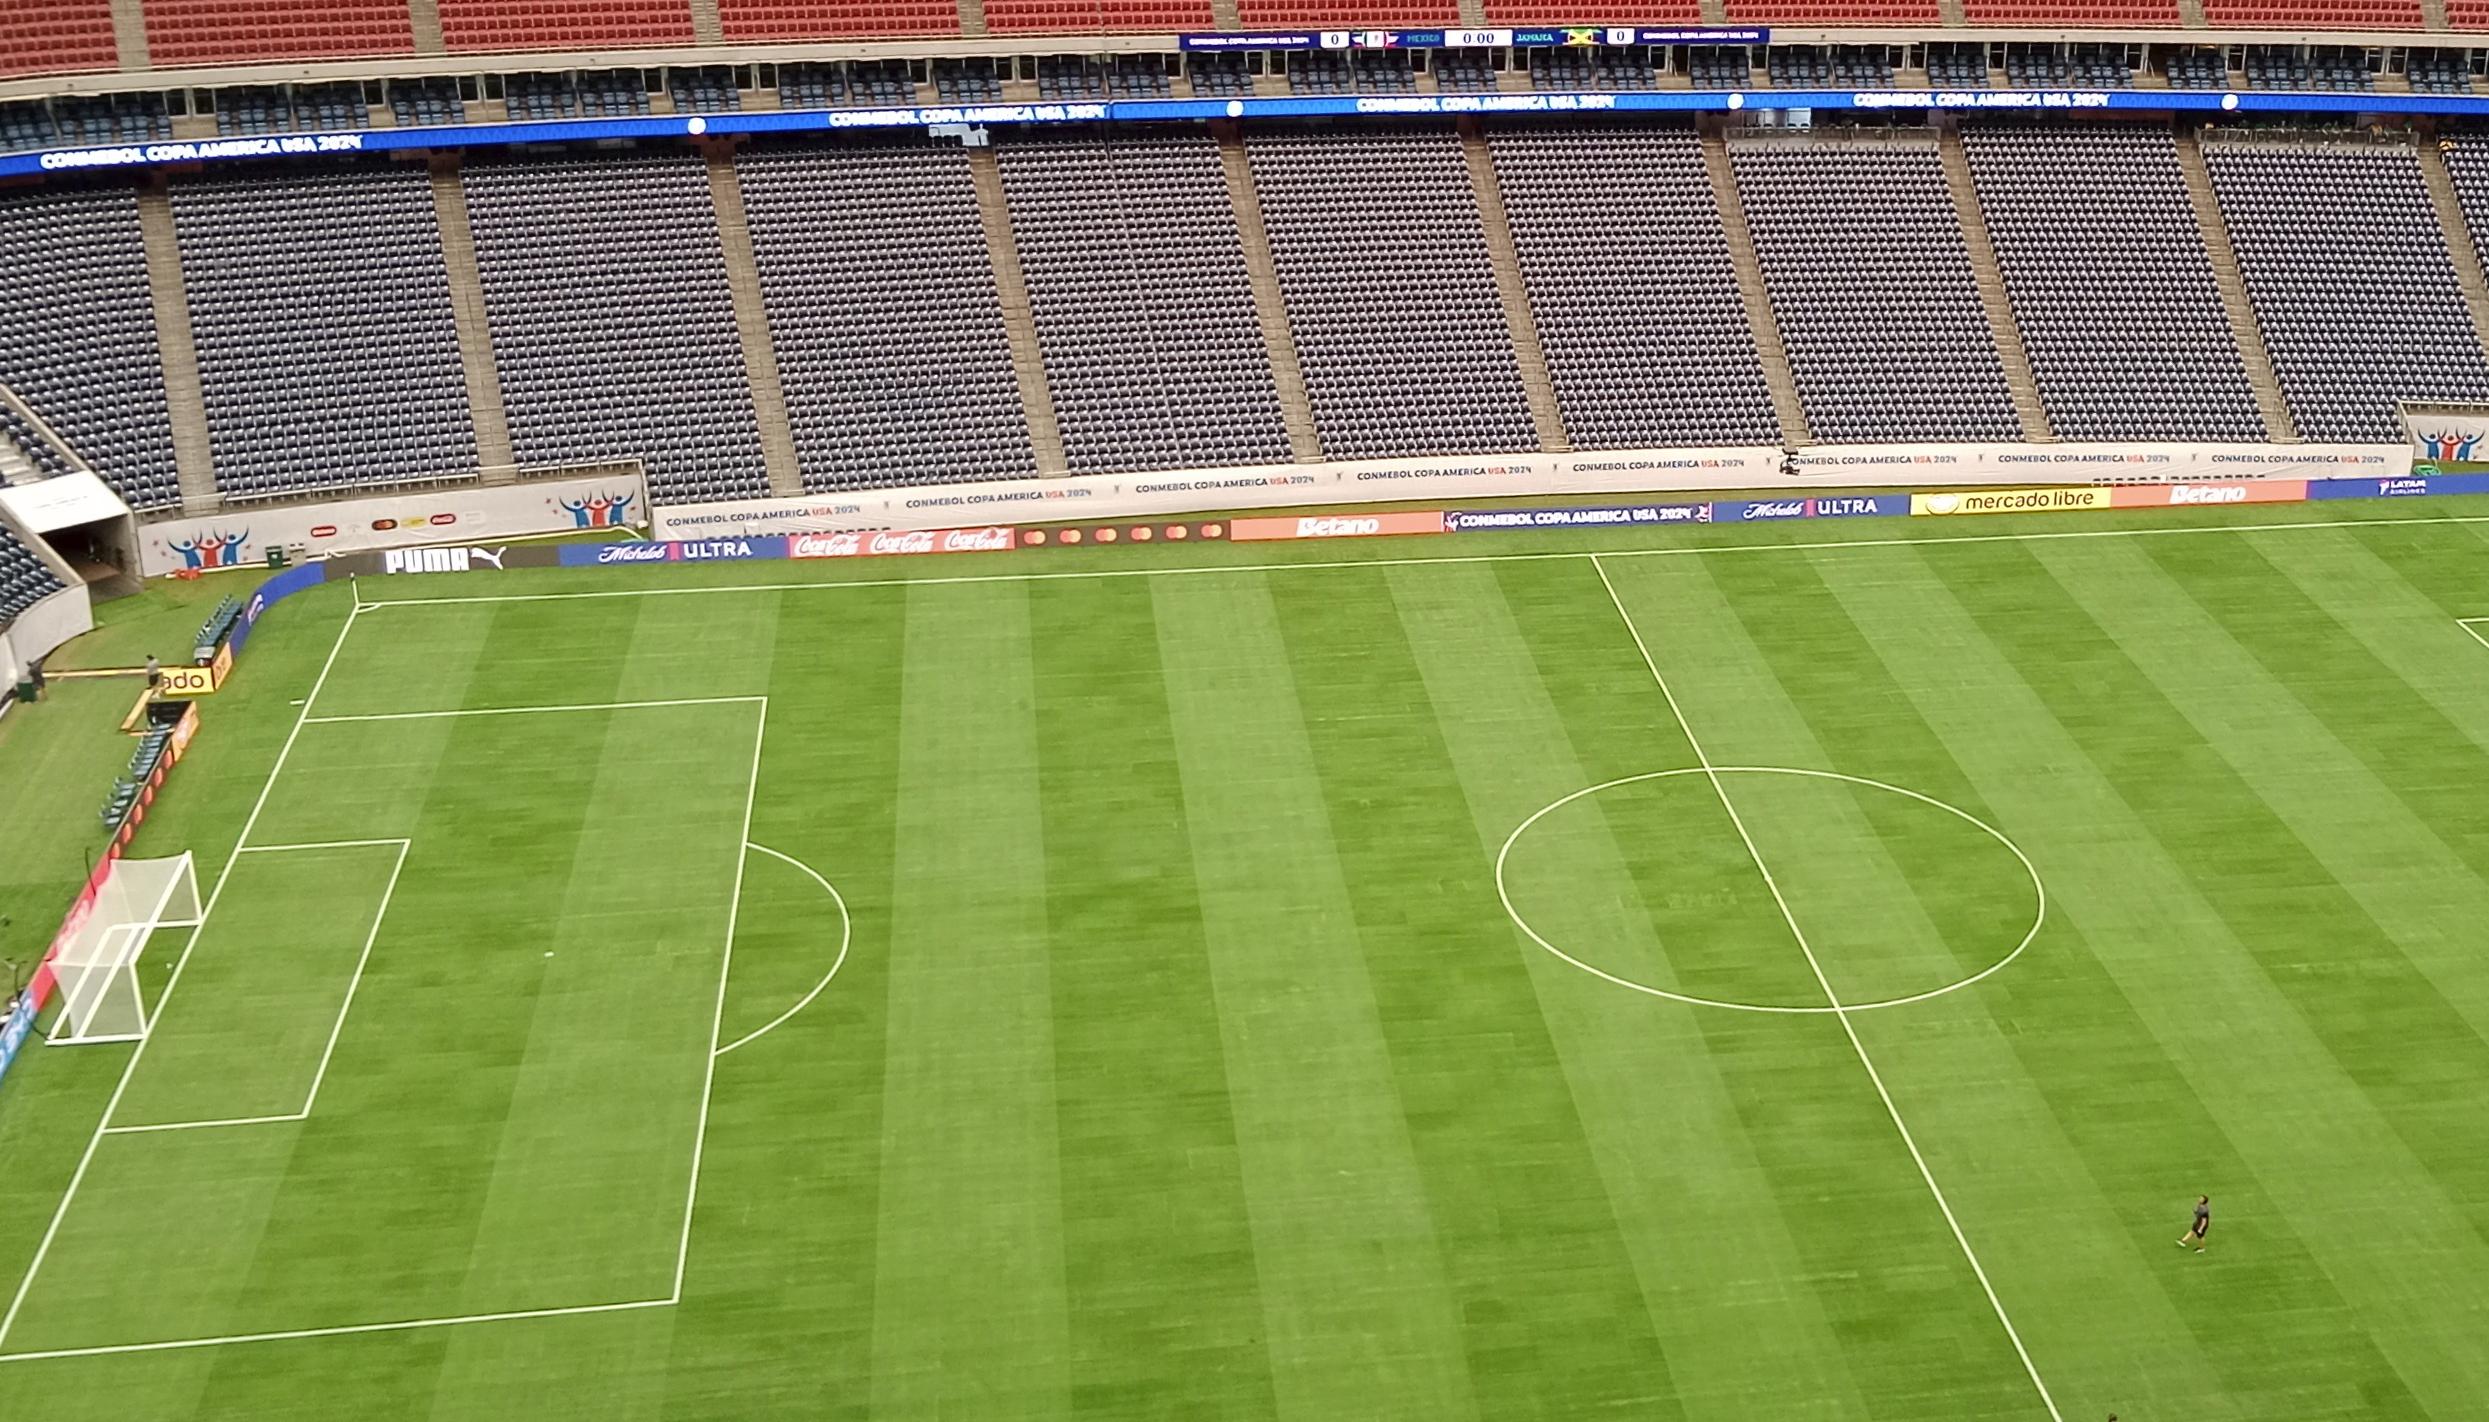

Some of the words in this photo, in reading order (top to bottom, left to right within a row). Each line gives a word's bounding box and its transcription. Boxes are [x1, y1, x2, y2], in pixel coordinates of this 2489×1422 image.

[1331, 34, 1339, 46] 0
[1616, 31, 1625, 42] 0
[1573, 462, 1627, 472] CONMEBOL
[1629, 461, 1655, 470] COPA
[1656, 459, 1699, 469] AMERICA
[1701, 459, 1719, 468] USA
[1721, 459, 1745, 467] 2024
[1841, 456, 1868, 465] COPA
[1869, 455, 1912, 464] AMERICA
[1914, 455, 1932, 464] USA
[1934, 455, 1957, 464] 2024
[1998, 454, 2052, 463] CONMEBOL
[2054, 454, 2079, 463] COPA
[2081, 454, 2125, 463] AMERICA
[2126, 454, 2145, 463] USA
[2146, 454, 2170, 463] 2024
[2212, 454, 2265, 463] CONMEBOL
[2267, 454, 2295, 463] COPA
[2296, 454, 2339, 463] AMERICA
[2341, 455, 2359, 463] USA
[2361, 455, 2385, 464] 2024
[1357, 470, 1413, 481] CONMEBOL
[1414, 469, 1440, 478] COPA
[1442, 467, 1486, 476] AMERICA
[1488, 466, 1506, 475] USA
[1508, 466, 1532, 474] 2024
[1136, 481, 1192, 493] CONMEBOL
[1194, 481, 1221, 490] COPA
[1223, 478, 1268, 488] AMERICA
[1270, 477, 1289, 485] USA
[1290, 476, 1314, 484] 2024
[2390, 480, 2426, 488] LATAM
[906, 497, 965, 508] CONMEBOL
[967, 494, 995, 504] COPA
[997, 491, 1044, 502] AMERICA
[1045, 490, 1065, 498] USA
[1066, 489, 1092, 497] 2024
[1966, 492, 2049, 509] mercado
[2053, 491, 2094, 505] libre
[2169, 485, 2247, 504] Betano
[666, 515, 728, 527] CONMEBOL
[730, 512, 761, 522] COPA
[762, 506, 811, 519] AMERICA
[812, 506, 833, 516] USA
[835, 505, 861, 515] 2024
[1460, 512, 1534, 527] CONMEBOL
[1535, 512, 1570, 525] COPA
[1572, 509, 1631, 524] AMERICA
[1633, 508, 1659, 521] USA
[1660, 507, 1693, 520] 2024
[1743, 502, 1804, 520] Michelob
[1817, 499, 1877, 515] ULTRA
[1296, 517, 1379, 537] Betano
[385, 547, 470, 574] PUMA
[599, 544, 668, 564] Michelob
[683, 541, 753, 558] ULTRA
